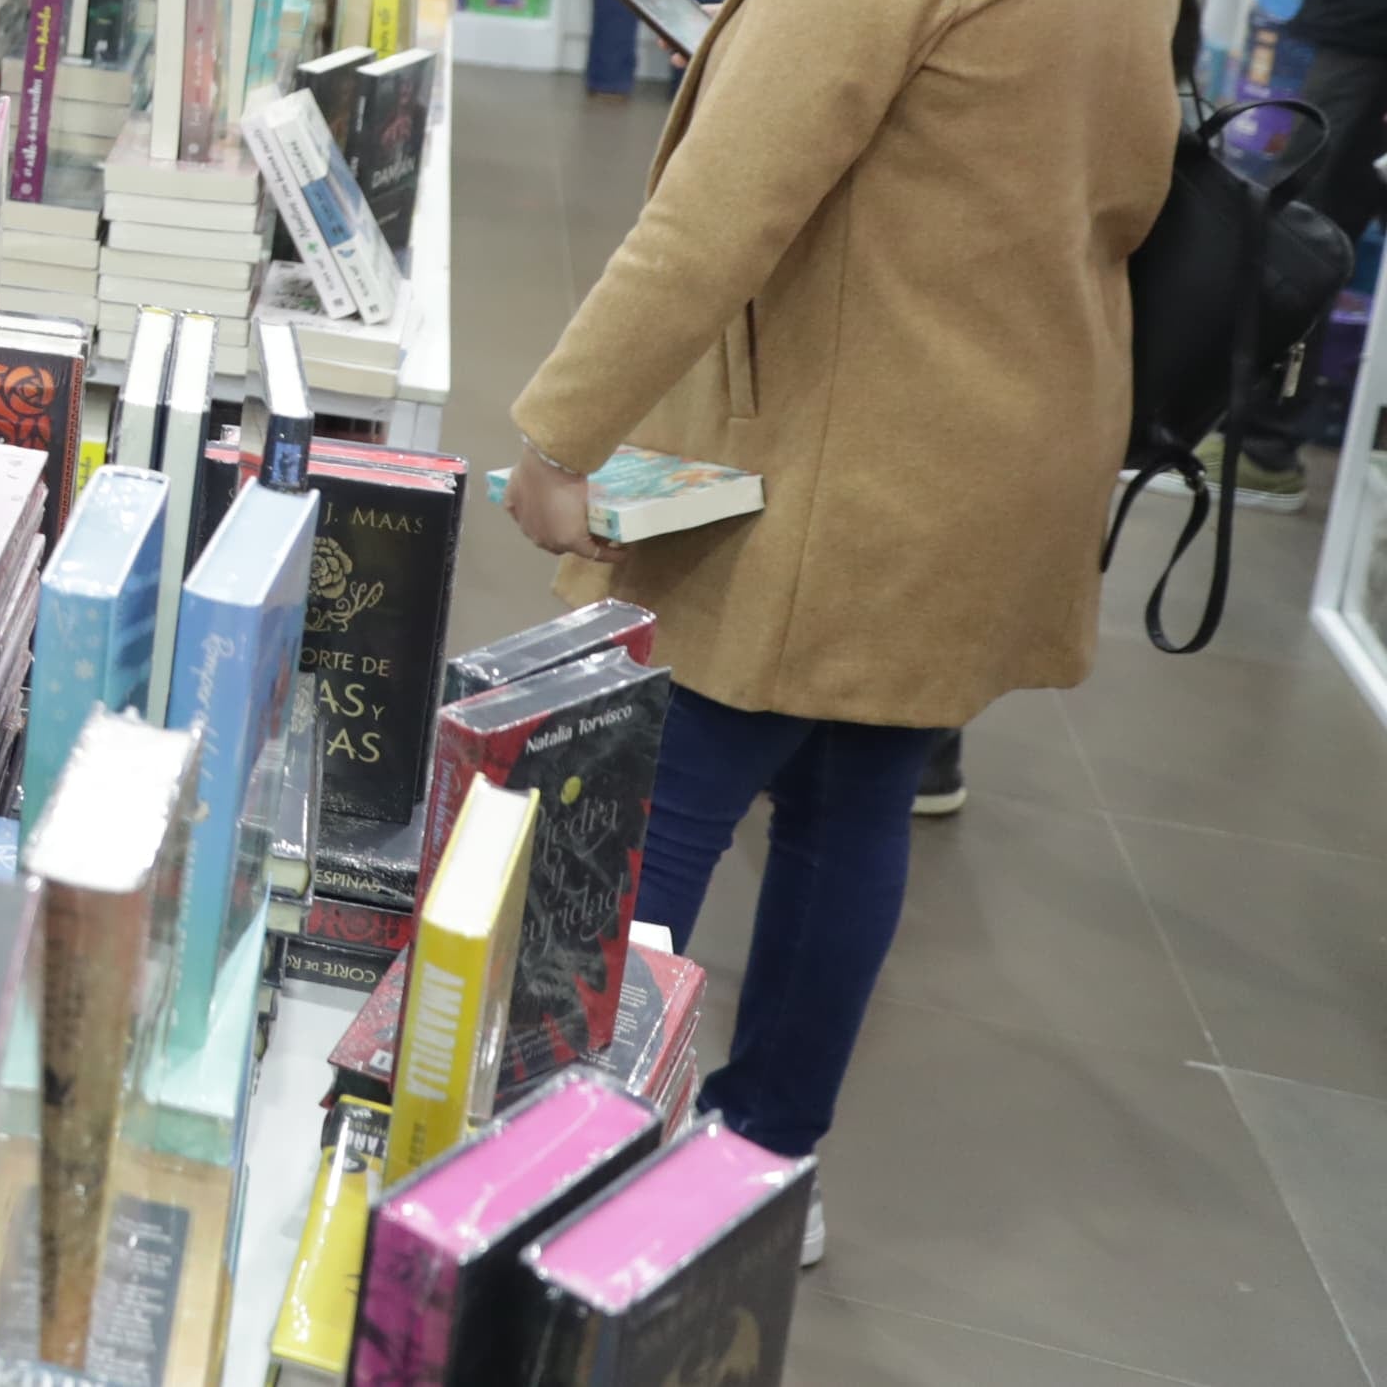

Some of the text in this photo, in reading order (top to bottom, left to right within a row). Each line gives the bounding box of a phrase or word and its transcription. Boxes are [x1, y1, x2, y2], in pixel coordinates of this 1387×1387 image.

[324, 500, 425, 535] J. MAAS
[301, 650, 391, 679] ORTE DE
[372, 705, 384, 722] Y
[524, 704, 633, 756] Natalia Torvisco
[314, 869, 382, 895] ESPINAS
[304, 959, 323, 974] DE
[325, 961, 377, 984] CORTE
[406, 961, 467, 1103] AMARILLA
